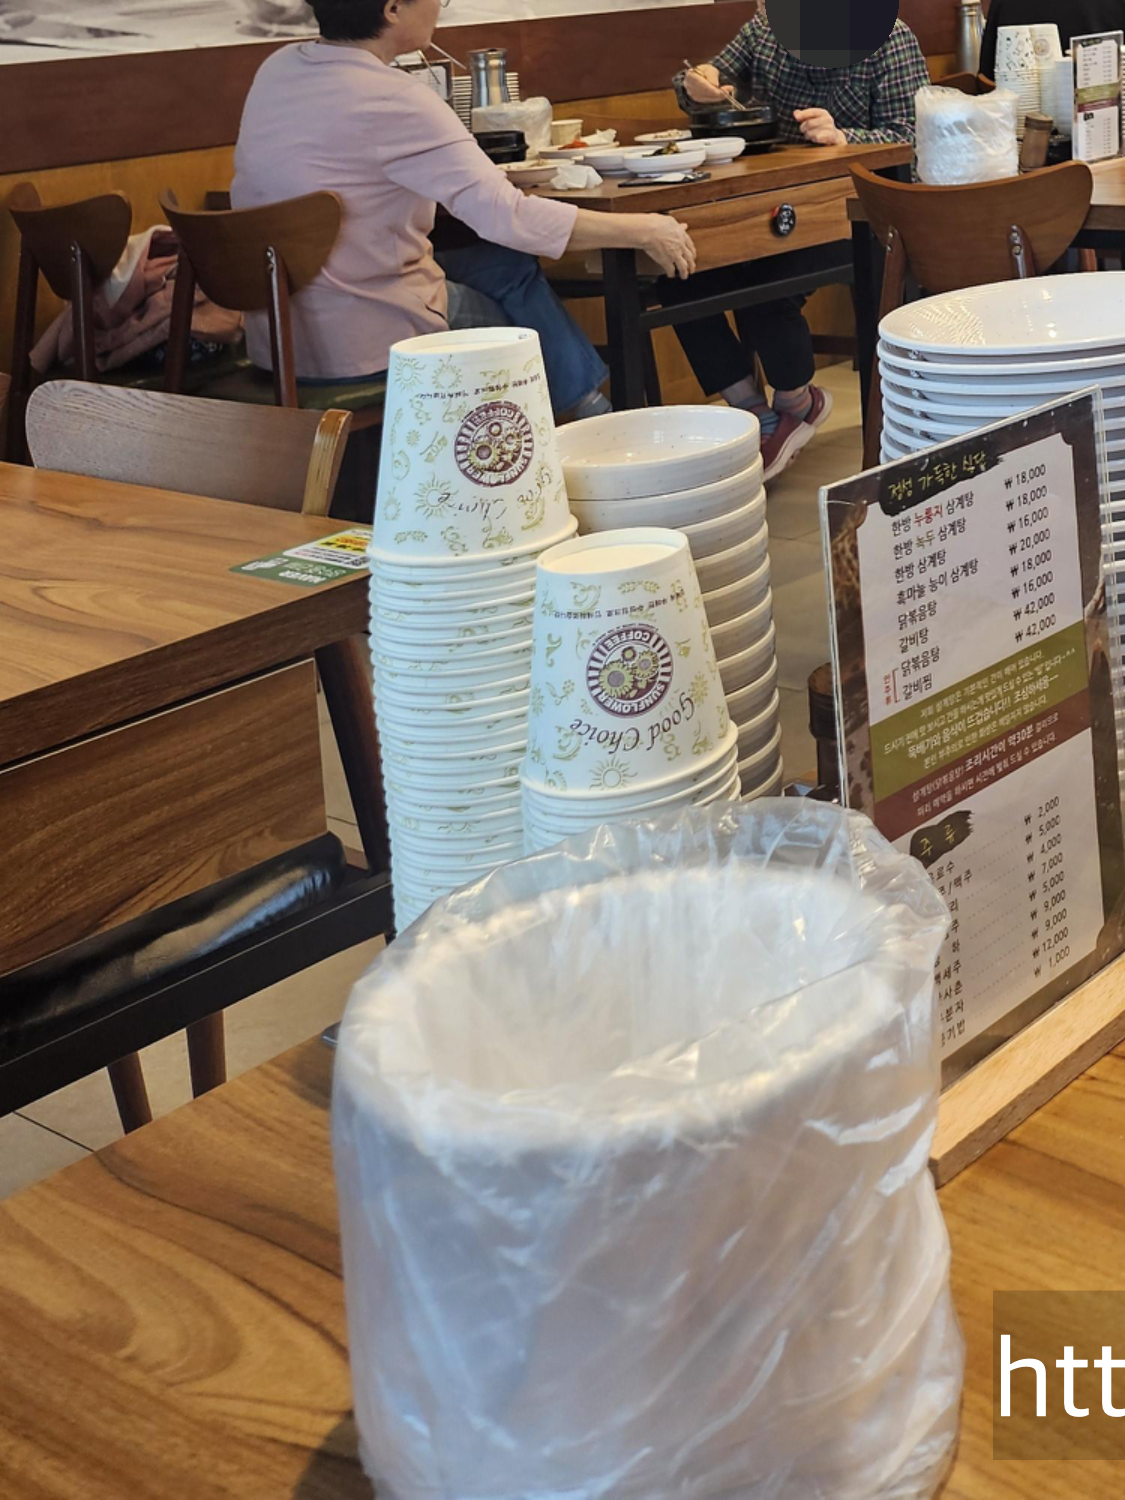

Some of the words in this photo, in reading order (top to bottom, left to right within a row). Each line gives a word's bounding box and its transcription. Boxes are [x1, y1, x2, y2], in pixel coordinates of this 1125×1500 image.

[888, 476, 913, 500] 정성
[918, 461, 958, 491] 가득한
[891, 516, 912, 537] 한방
[914, 503, 944, 528] 누룽지
[946, 490, 975, 516] 삼계탕
[1015, 463, 1047, 484] 18,000
[893, 539, 914, 561] 한방
[916, 530, 936, 550] 녹두
[937, 517, 967, 543] 삼계탕
[1017, 485, 1048, 507] 18,000
[894, 562, 915, 585] 한방
[917, 549, 947, 575] 삼계탕
[1018, 506, 1049, 529] 16,000
[950, 557, 979, 584] 삼계탕
[1020, 528, 1051, 551] 20,000
[898, 600, 938, 631] 닭볶음탕
[1022, 549, 1052, 572] 18,000
[899, 627, 930, 654] 갈비탕
[1023, 571, 1054, 594] 16,000
[604, 629, 651, 651] COFFEE
[901, 645, 940, 677] 닭볶음탕
[1024, 592, 1055, 615] 42,000
[902, 672, 933, 701] 갈비찜
[1026, 614, 1057, 637] 42,000
[600, 682, 666, 716] SUNFLOWER
[569, 717, 640, 755] Choice
[647, 690, 696, 751] Good
[943, 717, 965, 743] 음식이
[965, 739, 1005, 772] 조리시간이
[1038, 796, 1061, 818] 2,000
[1039, 815, 1061, 837] 5,000
[1040, 833, 1062, 855] 4,000
[1042, 852, 1064, 874] 7,000
[1042, 870, 1065, 894] 5,000
[1044, 889, 1066, 912] 9,000
[1045, 908, 1068, 931] 9,000
[1042, 926, 1069, 953] 12,000
[1048, 945, 1071, 968] 1,000
